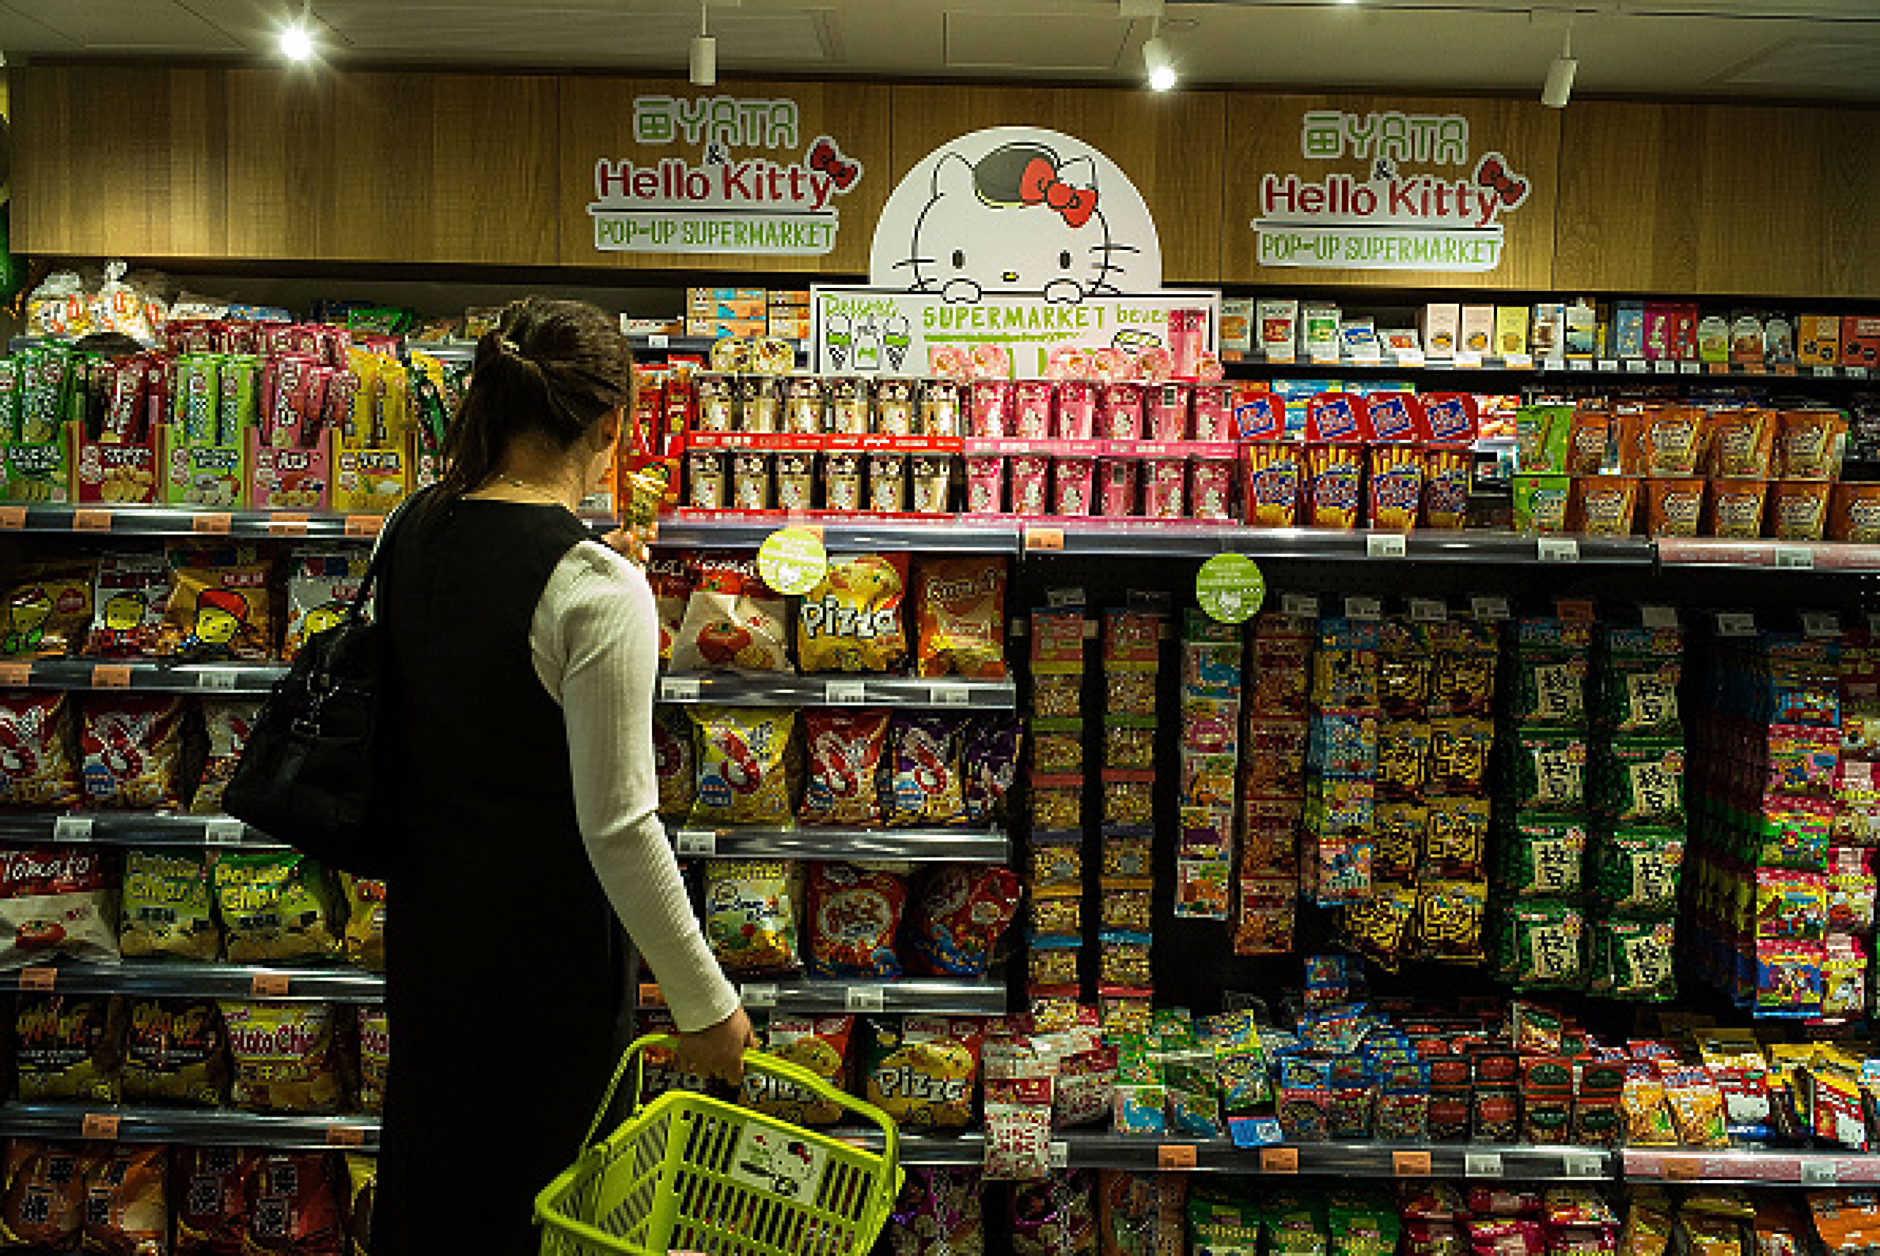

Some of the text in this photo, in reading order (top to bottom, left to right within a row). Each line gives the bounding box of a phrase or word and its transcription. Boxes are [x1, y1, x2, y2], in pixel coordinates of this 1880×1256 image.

[706, 144, 723, 165] &
[1374, 160, 1392, 180] &
[600, 162, 831, 210] Hello Kitty
[1265, 179, 1498, 227] Hello Kitty
[599, 218, 834, 248] POP-UP SUPERMARKET
[1262, 233, 1501, 264] POP-UP SUPERMARKET
[923, 305, 1105, 329] SUPERMARKET
[802, 594, 900, 641] Pizza
[1, 849, 91, 885] Tomato
[127, 874, 188, 902] Chips
[220, 883, 281, 911] Chips
[875, 1065, 967, 1104] Pizza
